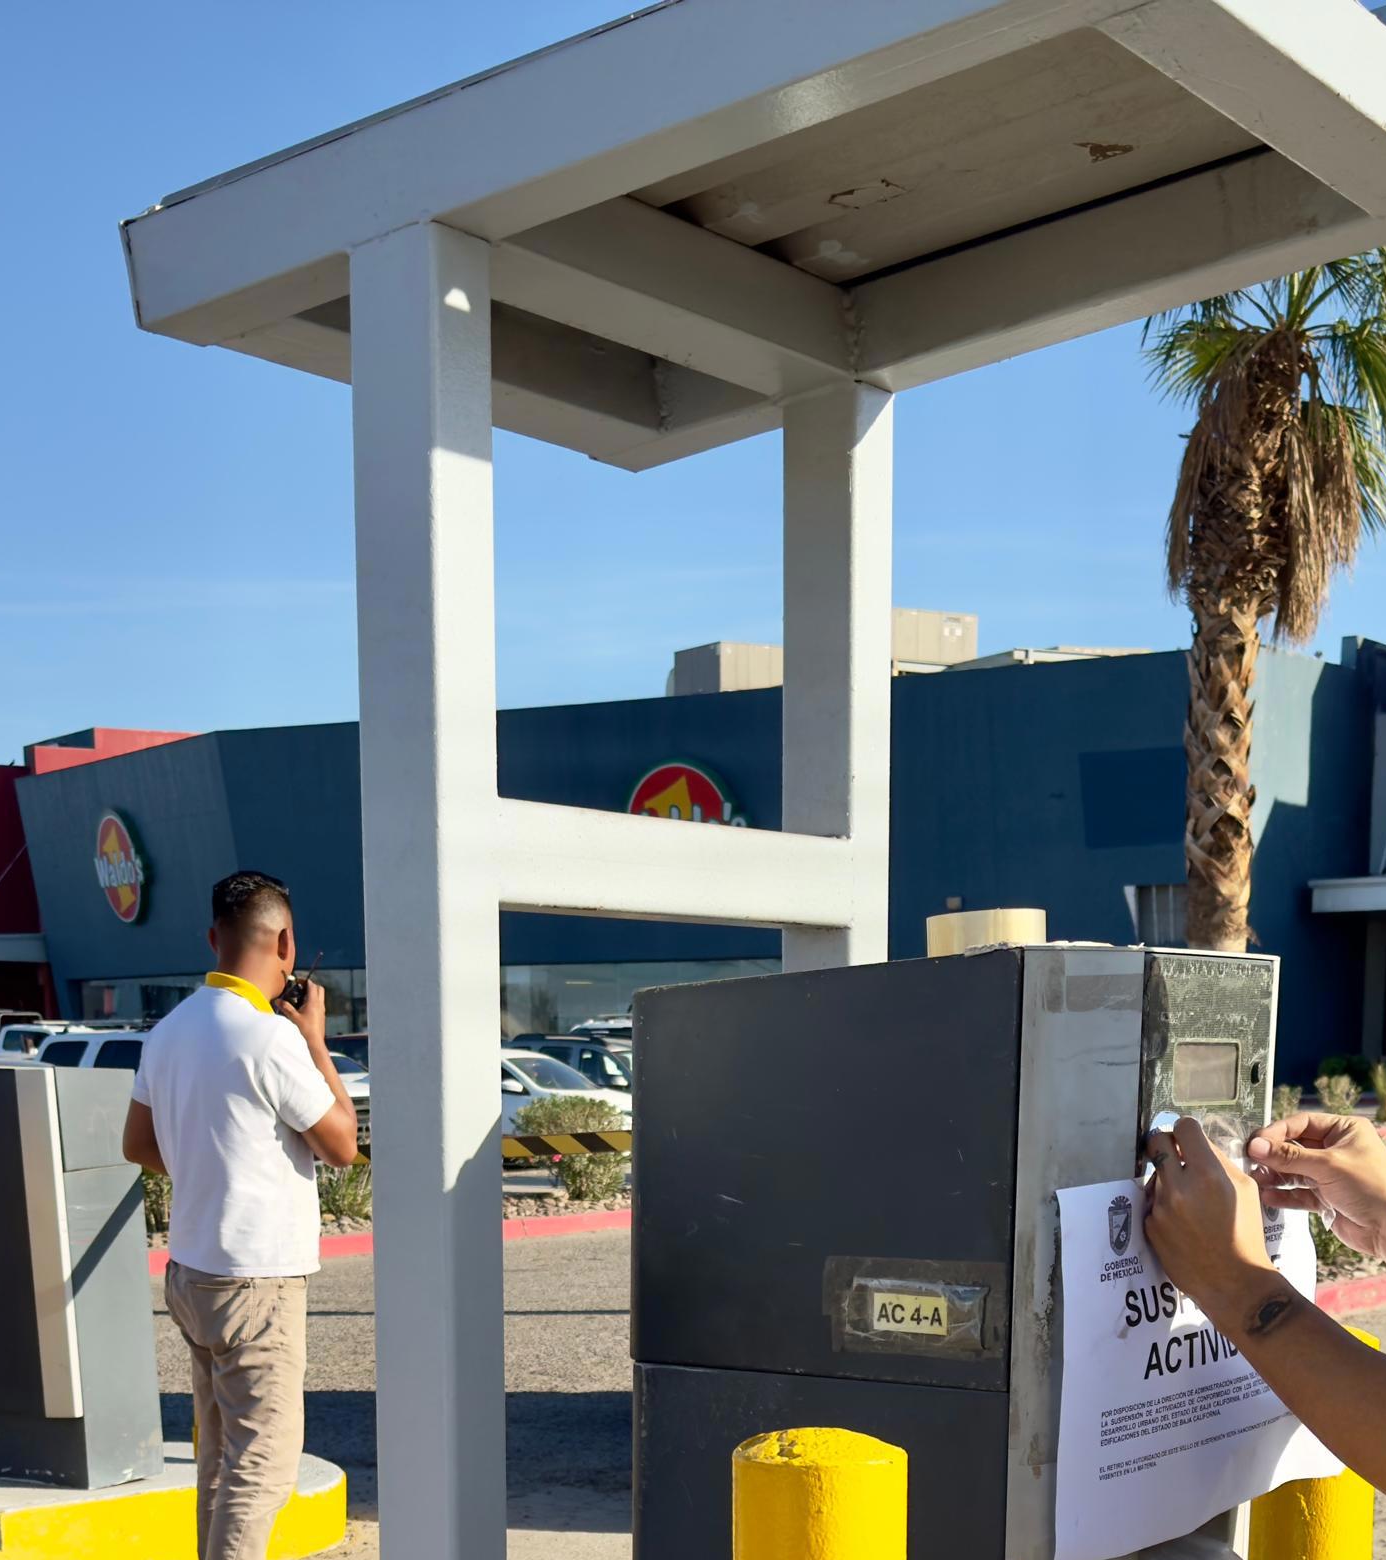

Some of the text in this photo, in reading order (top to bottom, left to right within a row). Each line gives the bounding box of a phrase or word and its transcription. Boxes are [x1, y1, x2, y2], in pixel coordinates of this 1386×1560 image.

[1100, 1266, 1144, 1283] DE MEXICALI
[1104, 1255, 1139, 1273] GOBIERNO
[877, 1302, 943, 1327] AC 4-A
[1100, 1423, 1137, 1437] DESARROLLO
[1137, 1417, 1159, 1429] URBANO
[1160, 1413, 1170, 1423] DEL
[1171, 1408, 1191, 1420] ESTADO
[1101, 1409, 1113, 1420] POR
[1100, 1431, 1140, 1447] EDIFICACIONES
[1140, 1428, 1151, 1437] DEL
[1151, 1422, 1172, 1434] ESTADO
